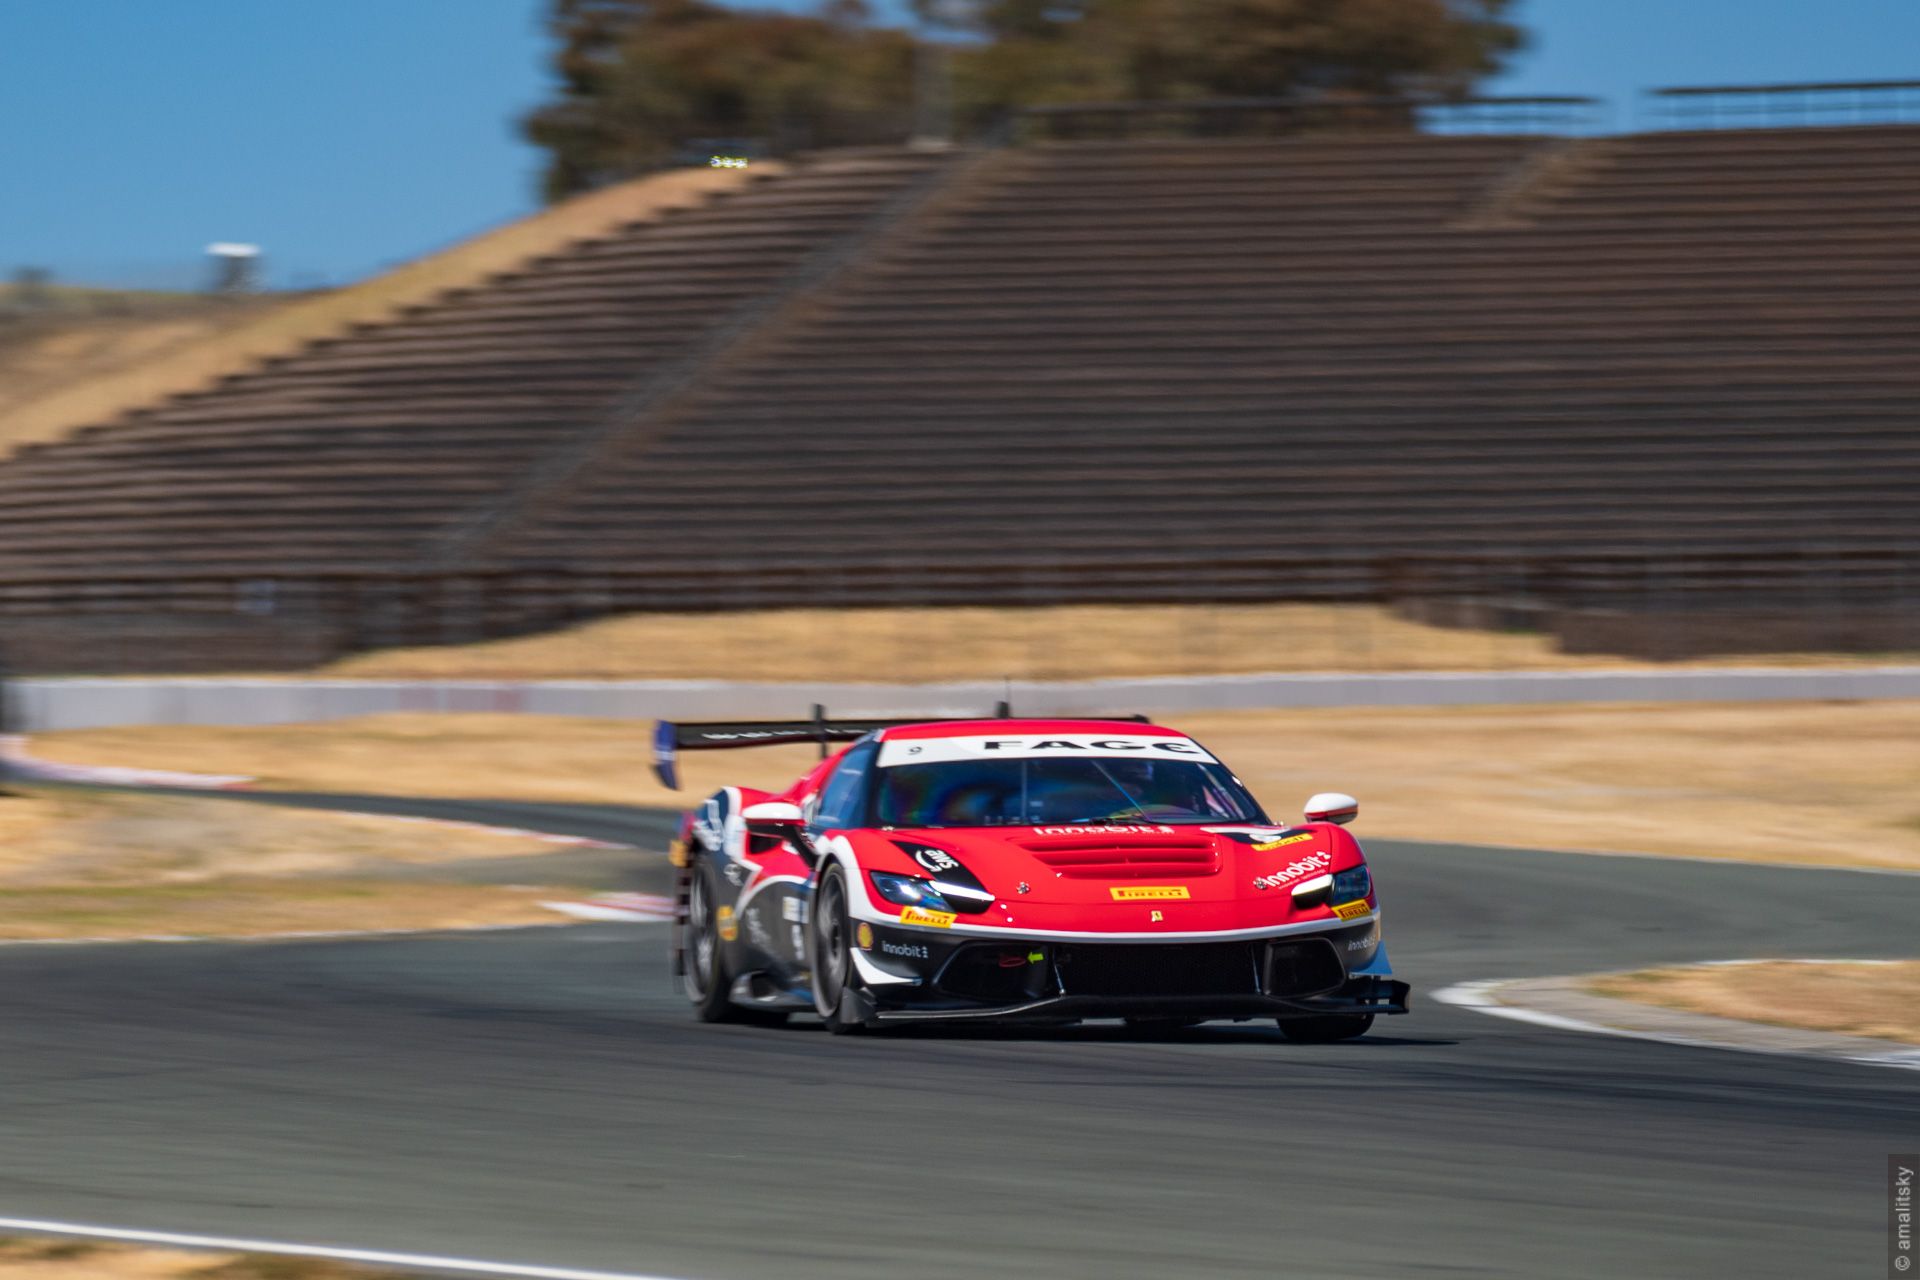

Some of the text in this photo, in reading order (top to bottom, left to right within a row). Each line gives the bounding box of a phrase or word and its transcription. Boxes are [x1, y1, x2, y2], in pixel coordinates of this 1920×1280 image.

[924, 849, 959, 869] aws
[904, 910, 951, 925] PIRELLI
[882, 941, 922, 957] innobit
